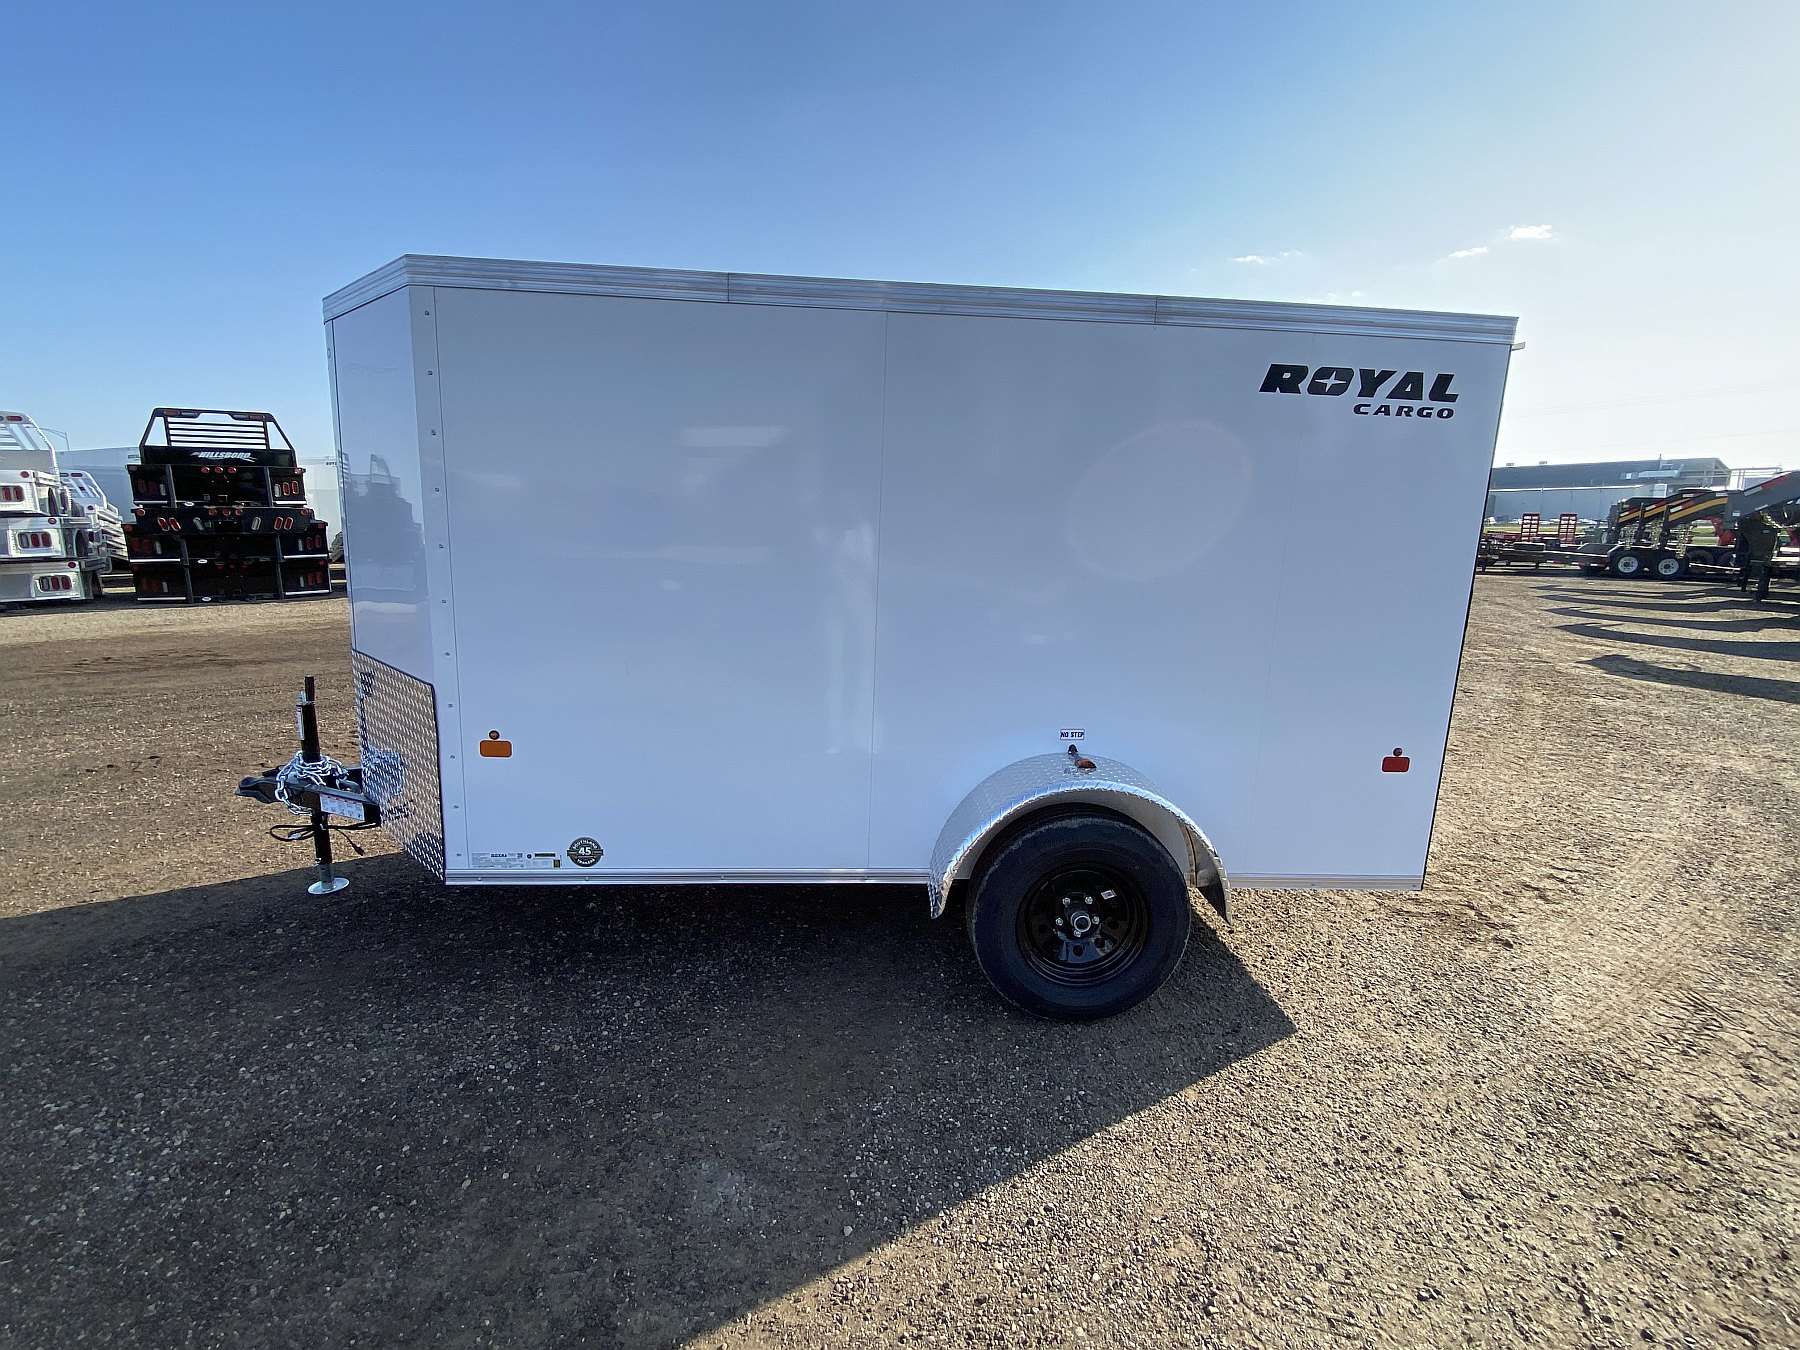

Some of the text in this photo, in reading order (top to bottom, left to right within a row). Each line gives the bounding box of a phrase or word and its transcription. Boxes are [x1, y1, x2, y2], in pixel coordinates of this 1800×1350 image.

[1259, 364, 1459, 402] ROYAL
[1353, 403, 1455, 419] CARGO
[578, 847, 592, 856] 45
